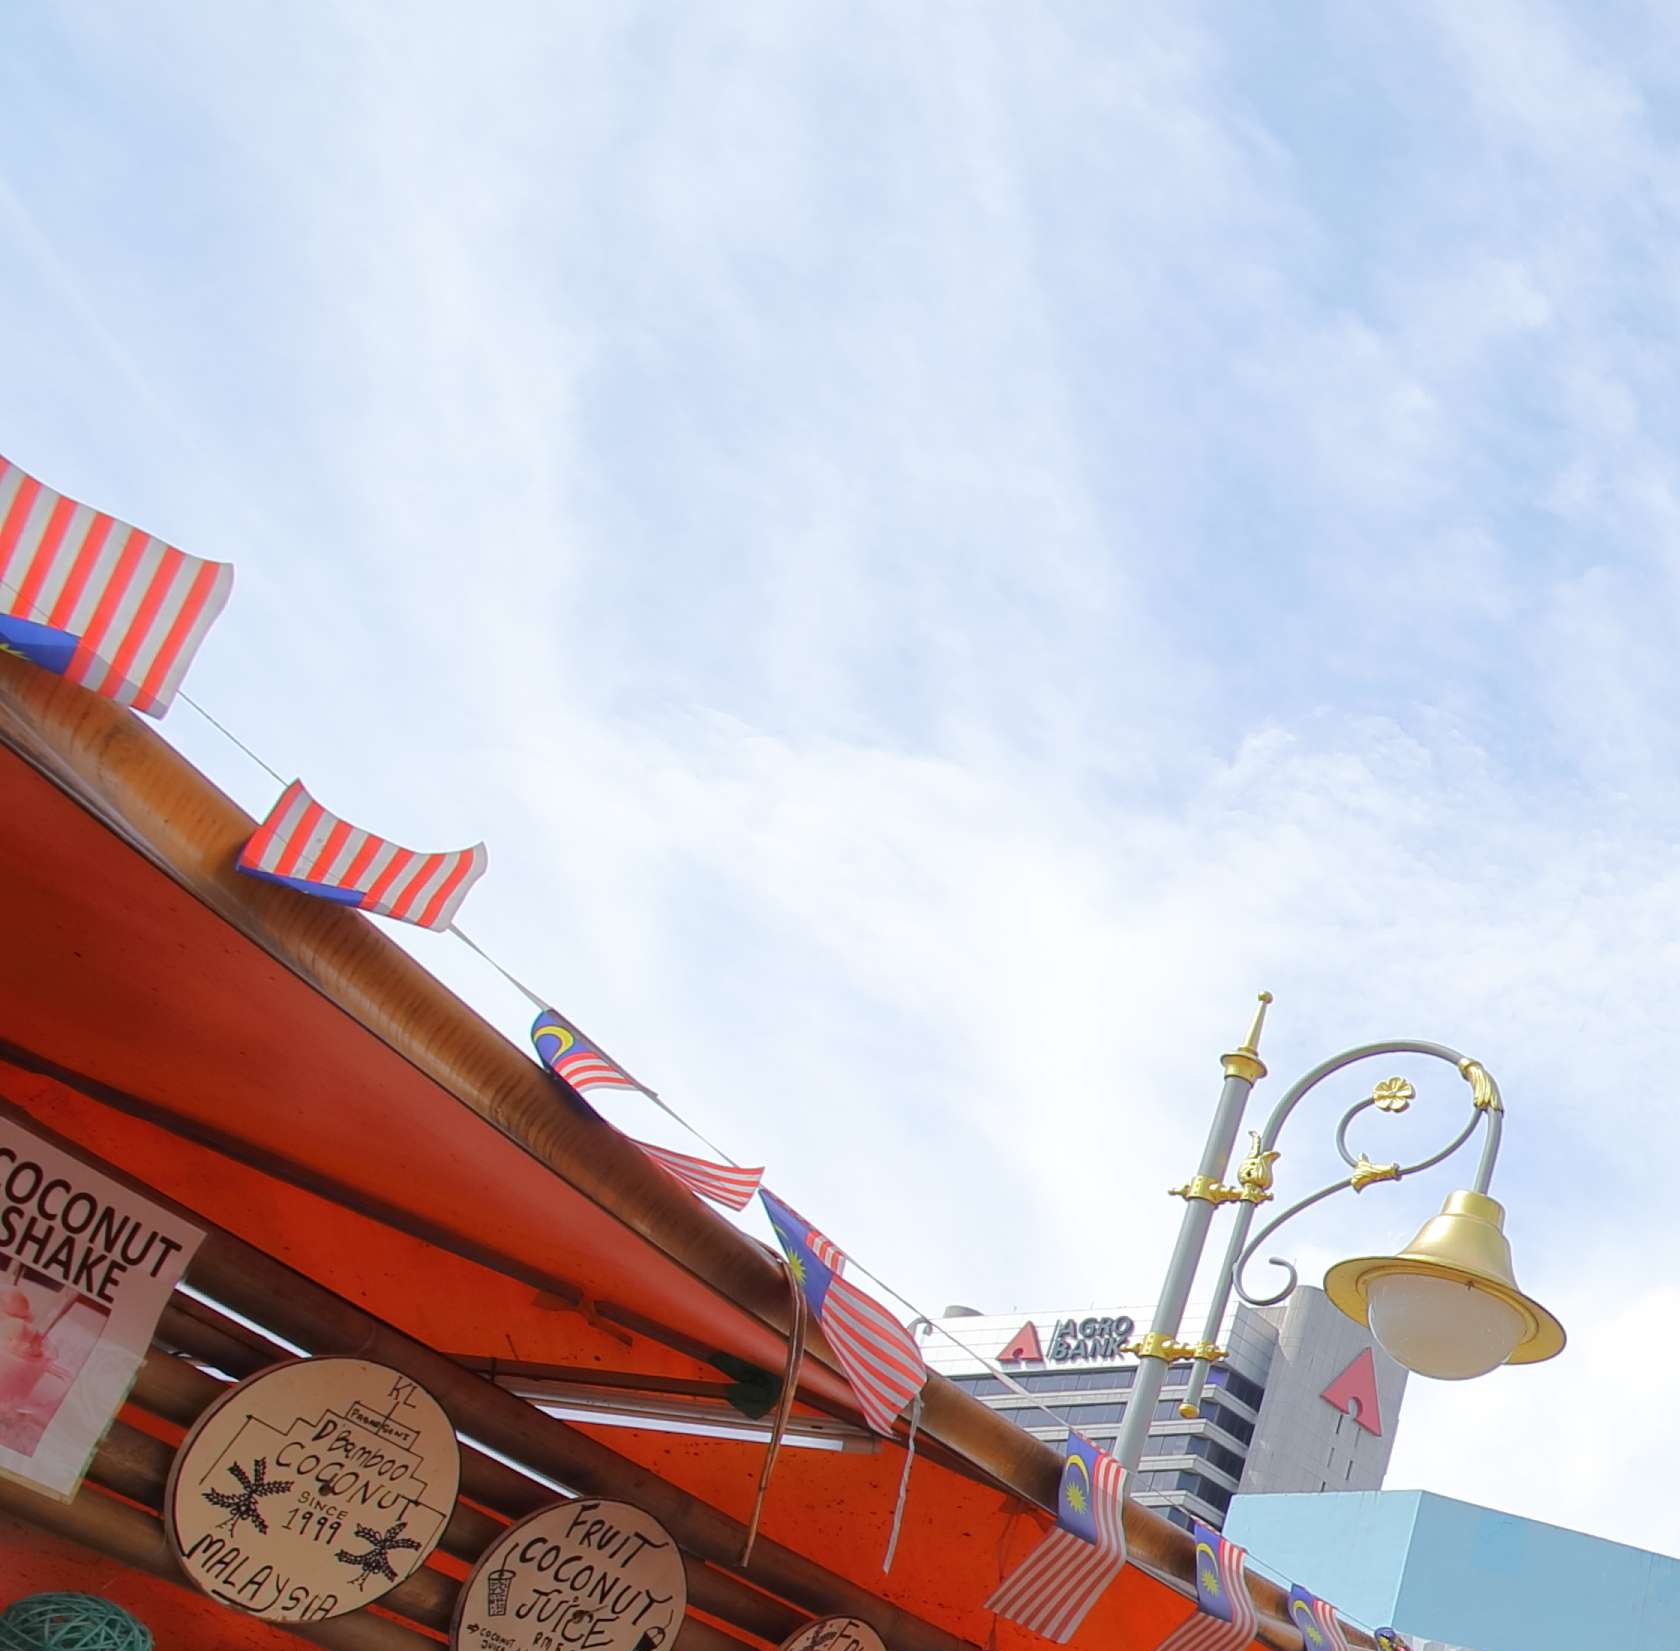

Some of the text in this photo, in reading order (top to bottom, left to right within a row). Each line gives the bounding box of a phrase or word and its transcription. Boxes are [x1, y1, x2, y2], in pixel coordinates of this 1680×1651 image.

[0, 1205, 128, 1304] SHAKE
[1053, 1337, 1127, 1361] BANK
[1057, 1316, 1135, 1338] AGRO
[388, 1377, 417, 1409] KL
[276, 1441, 419, 1522] COCONUT
[297, 1491, 349, 1520] SINCE
[282, 1508, 342, 1544] 1999
[565, 1504, 669, 1568] FRUIT
[187, 1533, 338, 1620] MALAYSIA
[519, 1537, 673, 1625] COCONUT
[515, 1589, 619, 1649] JUICE
